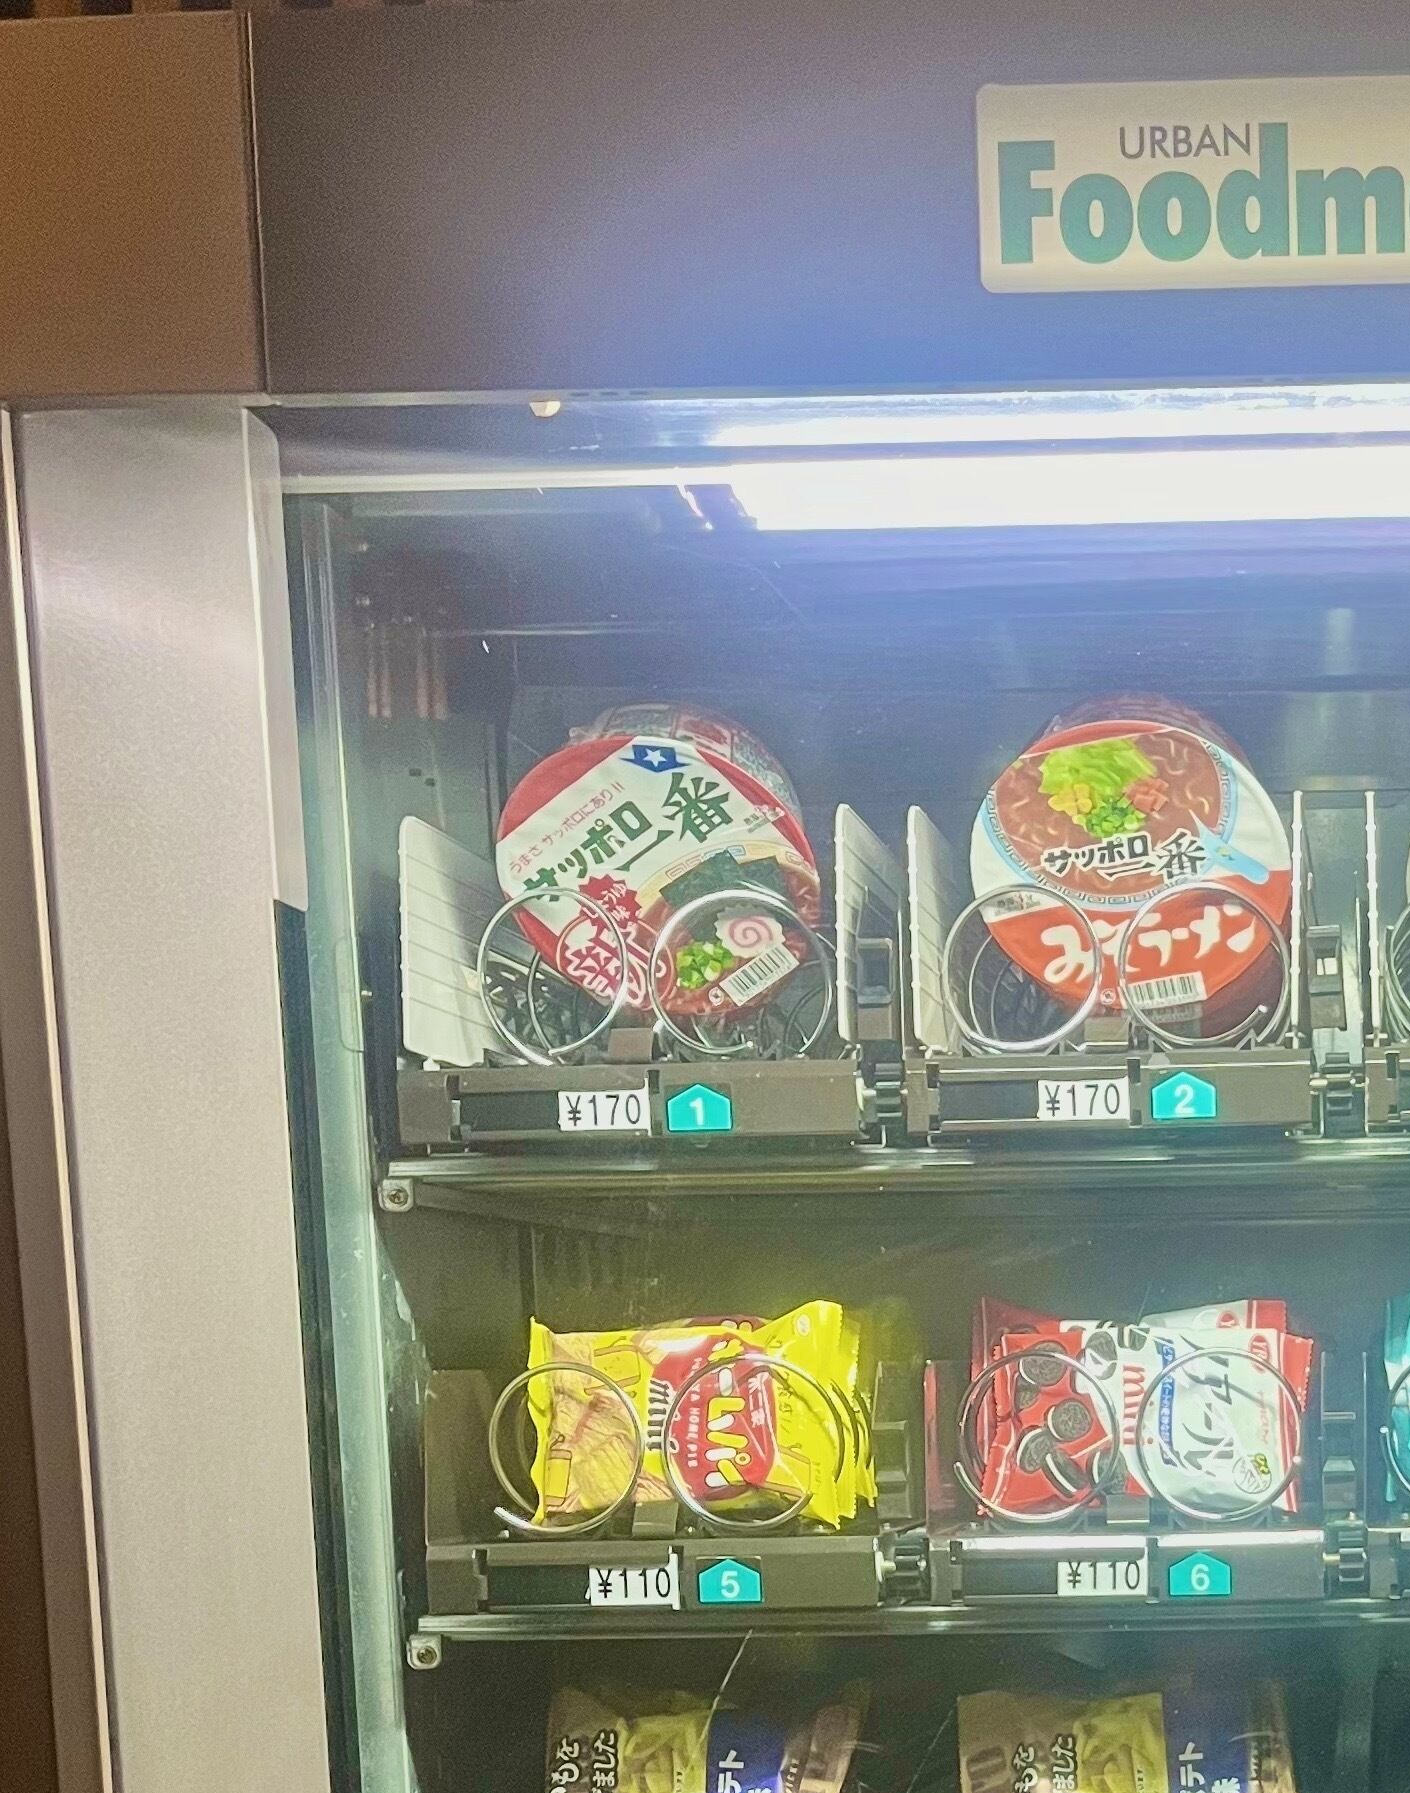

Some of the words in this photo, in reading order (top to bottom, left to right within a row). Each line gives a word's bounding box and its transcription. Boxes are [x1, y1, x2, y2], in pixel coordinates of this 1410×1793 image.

[1118, 122, 1251, 159] URBAN
[522, 771, 734, 904] サッポロ一番
[1042, 829, 1208, 885] サッポロ一番
[1041, 903, 1258, 985] みそラーメン
[566, 1094, 641, 1128] ¥170
[689, 1099, 704, 1126] 1
[1045, 1084, 1121, 1117] ¥170
[1174, 1085, 1195, 1115] 2
[596, 1567, 671, 1601] ¥110
[720, 1570, 741, 1599] 5
[1066, 1561, 1140, 1590] ¥110
[1190, 1563, 1211, 1592] 6
